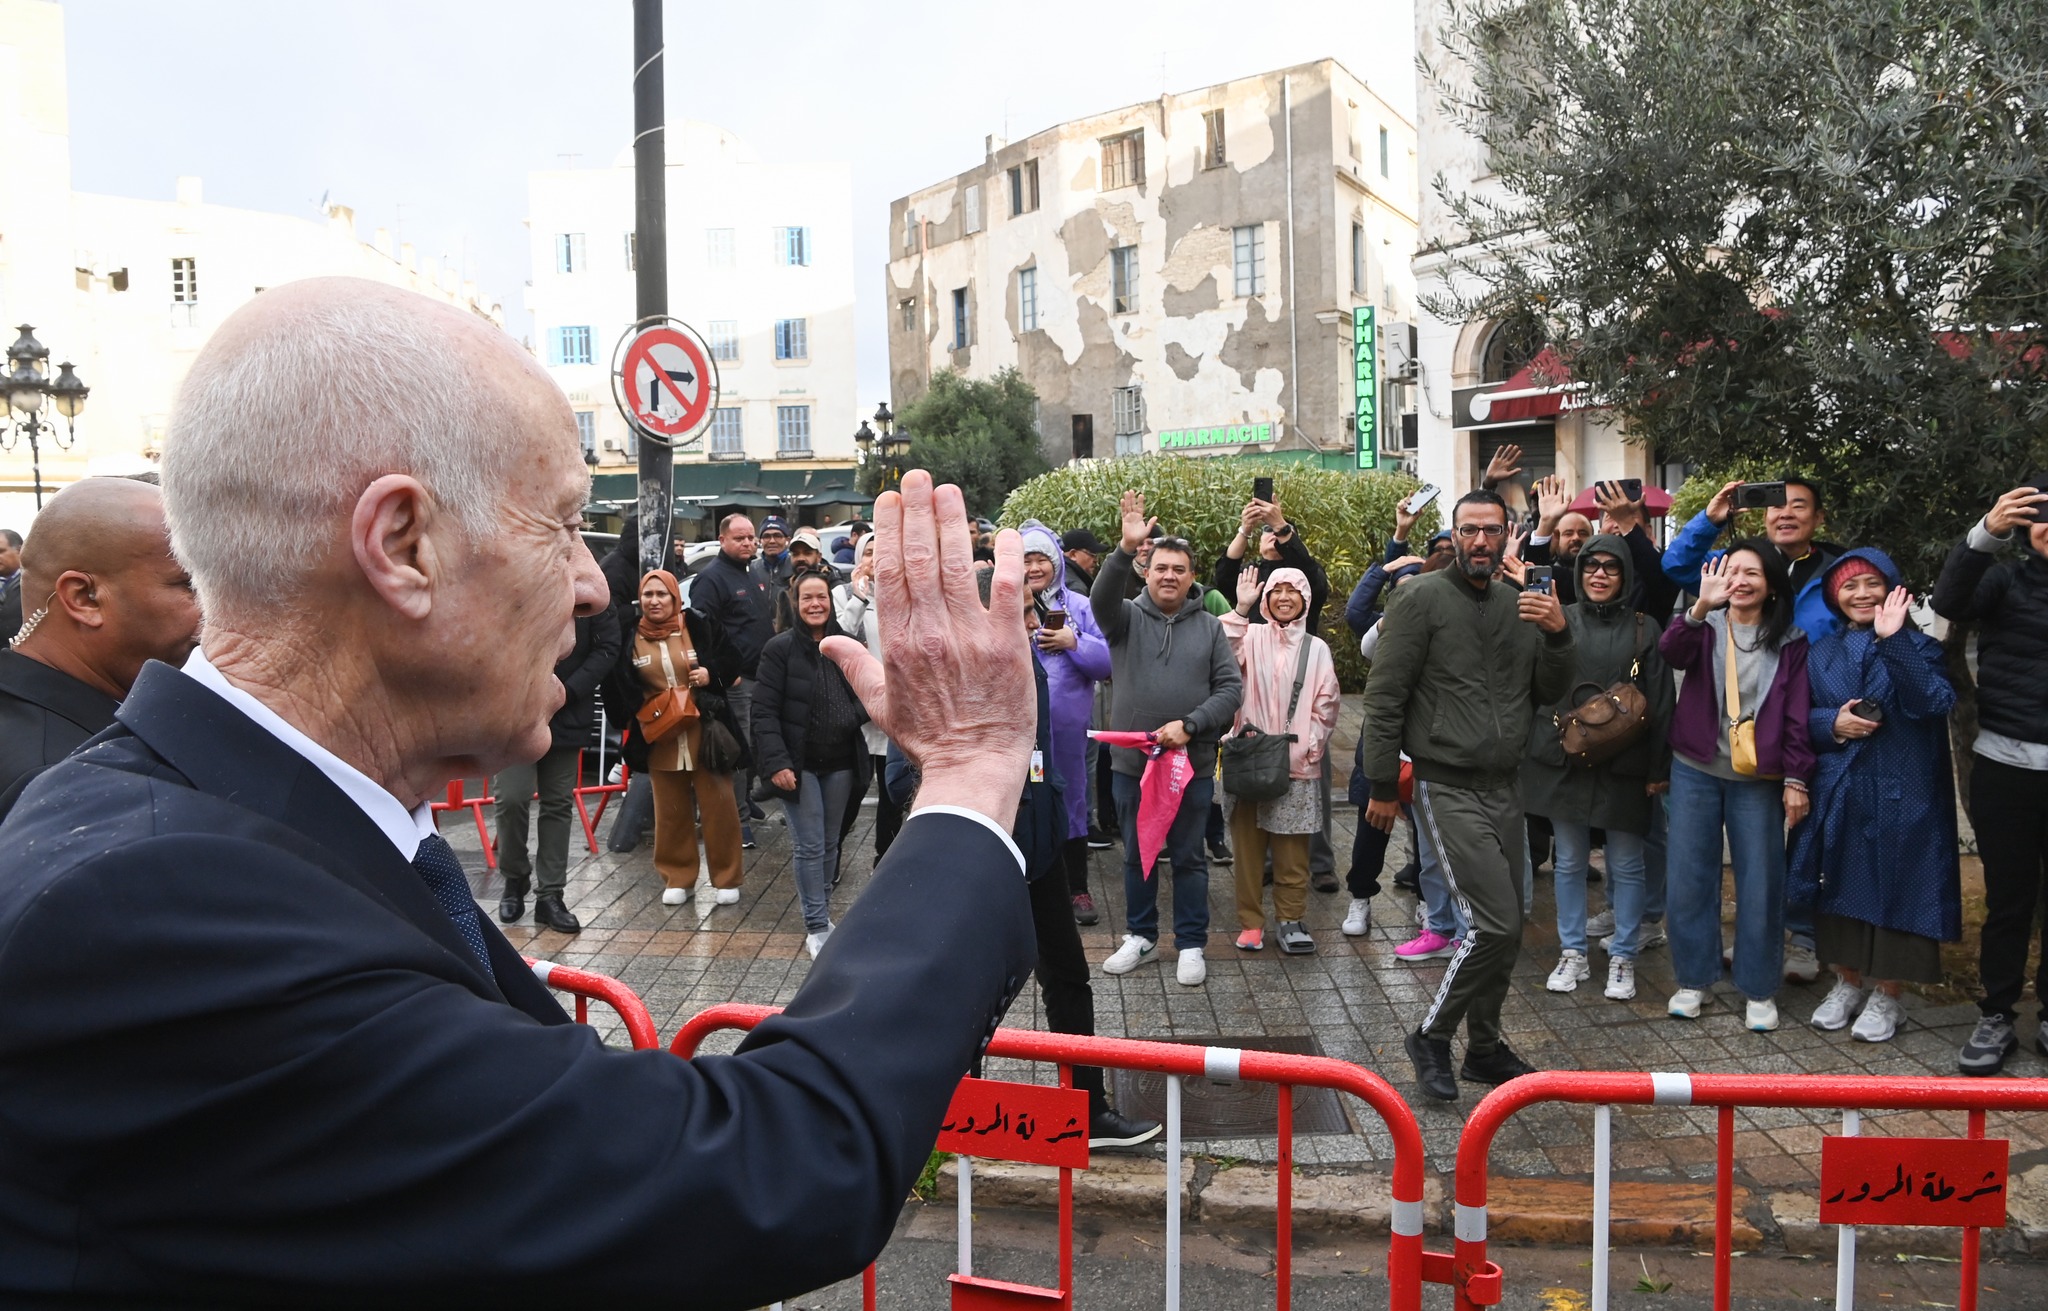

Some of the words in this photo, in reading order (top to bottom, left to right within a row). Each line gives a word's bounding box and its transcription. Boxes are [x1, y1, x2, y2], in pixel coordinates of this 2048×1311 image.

[1356, 307, 1374, 468] PHARMACIE
[1160, 424, 1270, 448] PHARMACIE
[1826, 1163, 1913, 1204] المرور
[1920, 1170, 2003, 1203] شرطة
